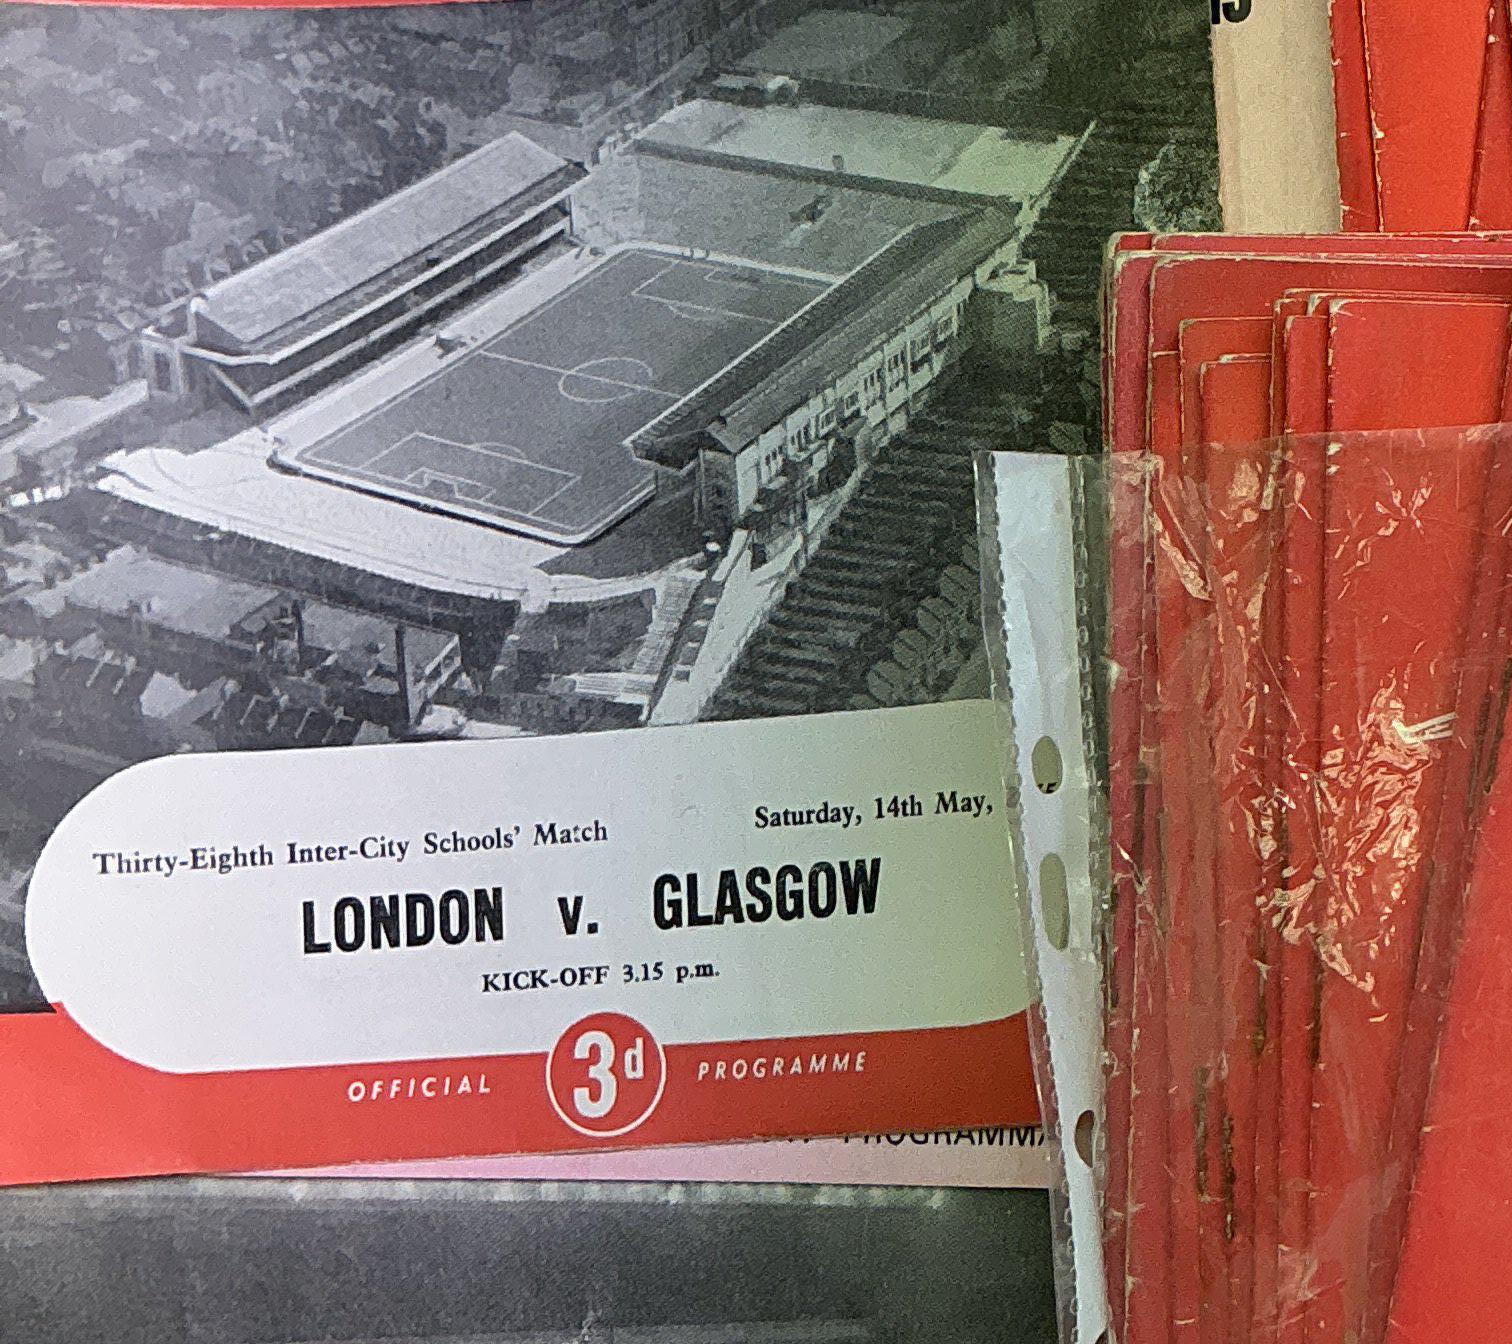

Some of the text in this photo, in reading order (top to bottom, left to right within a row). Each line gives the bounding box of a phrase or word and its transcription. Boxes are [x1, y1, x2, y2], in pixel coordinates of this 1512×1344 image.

[754, 789, 994, 830] Saturday, 14th May,
[92, 819, 608, 877] Thirty-Eighth Inter-City Schools' Match
[301, 858, 882, 955] LONDON v. GLASGOW
[481, 961, 720, 993] KICK-OFF 3.15 p.m.
[346, 1029, 867, 1119] OFFICIAL 3d PROGRAMME
